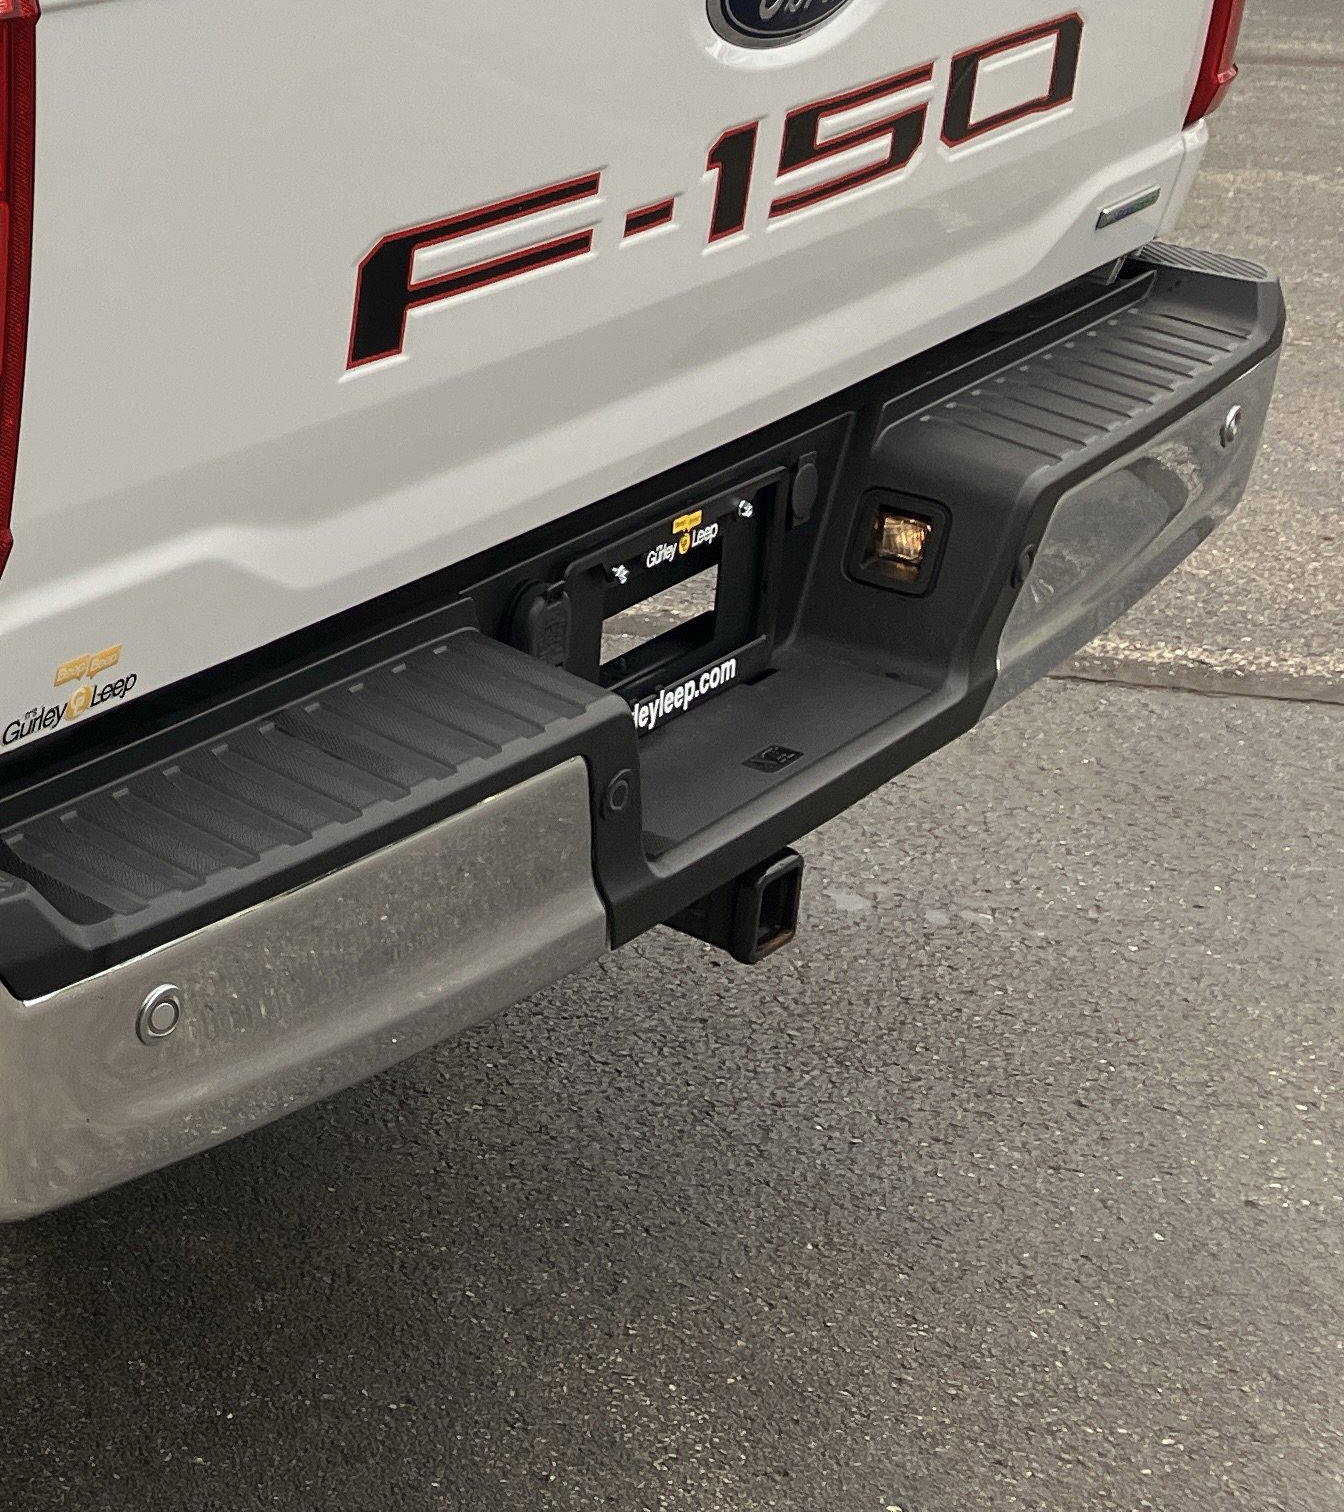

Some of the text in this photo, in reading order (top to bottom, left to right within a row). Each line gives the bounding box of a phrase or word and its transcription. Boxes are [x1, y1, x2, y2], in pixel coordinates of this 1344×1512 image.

[345, 11, 1085, 371] F-150
[691, 523, 719, 547] Leep
[2, 673, 137, 745] Gurley Leep
[632, 658, 737, 730] leyleep.com
